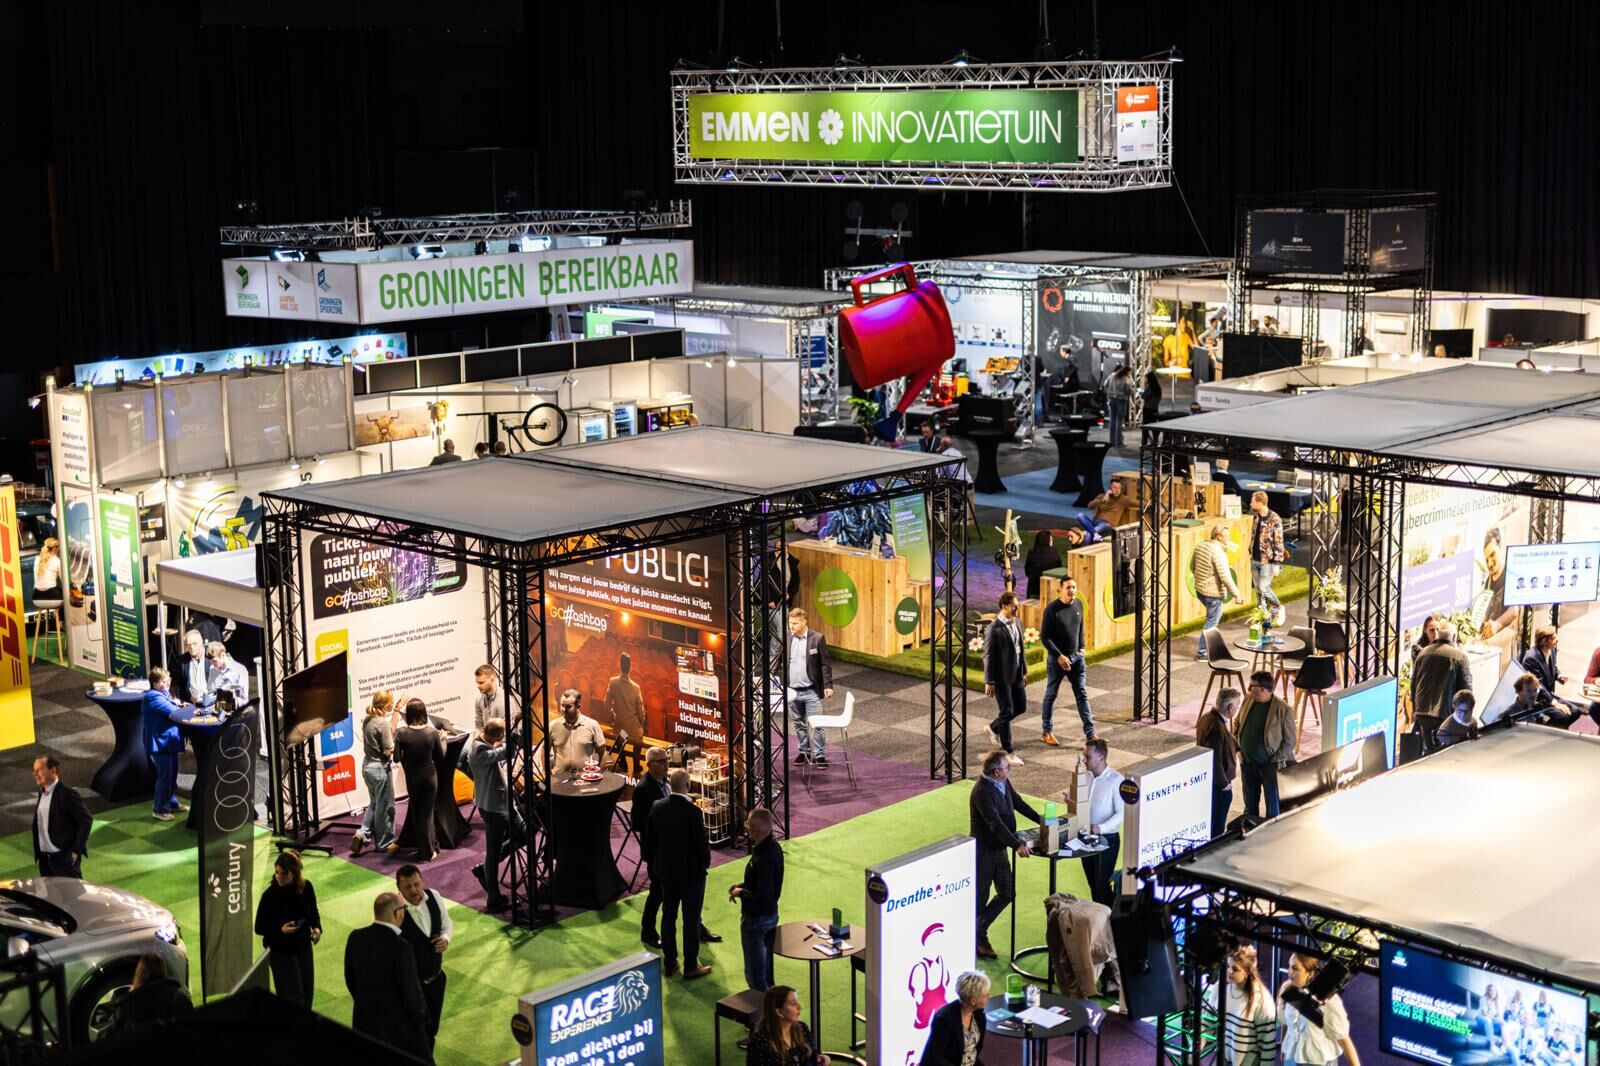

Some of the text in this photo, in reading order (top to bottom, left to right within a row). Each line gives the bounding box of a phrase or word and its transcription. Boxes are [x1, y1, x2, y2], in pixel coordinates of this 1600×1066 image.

[379, 252, 679, 311] GRONINGEN BEREIKBAAR
[324, 548, 393, 570] naar jouw
[324, 563, 377, 588] publiek
[548, 568, 712, 610] Wij zorgen dat jouw bedrijf de juiste aandacht krijgt,
[549, 581, 557, 590] bij
[558, 582, 568, 591] het
[569, 585, 585, 595] juiste
[586, 590, 610, 601] publiek,
[621, 596, 632, 604] het
[632, 598, 650, 609] juiste
[651, 603, 677, 614] moment
[688, 610, 712, 622] kanaal.
[356, 637, 379, 646] Genereer
[416, 622, 450, 633] zichtbaarheid
[320, 642, 344, 652] SOCIAL
[359, 684, 372, 692] hoog
[386, 676, 412, 685] resultaten
[429, 666, 454, 676] bekendste
[386, 671, 400, 679] juiste
[401, 663, 434, 675] zoekwoorden
[435, 657, 458, 667] organisch
[396, 683, 413, 691] Google
[678, 700, 721, 718] Haal hier je
[680, 712, 720, 730] ticket voor
[330, 730, 344, 740] SEA
[675, 722, 726, 743] jouw publiek!
[327, 771, 352, 782] E-MAIL
[1145, 782, 1181, 802] KENNETH
[1190, 772, 1207, 786] SMIT
[1141, 842, 1154, 854] HOE
[1190, 821, 1206, 835] JOUW
[227, 842, 247, 914] century
[886, 887, 933, 913] Drenthe
[944, 877, 971, 895] tours
[1392, 1001, 1469, 1028] OOK DE TALENTEN
[1392, 1007, 1410, 1017] VAN
[1412, 1013, 1423, 1022] DE
[546, 1052, 578, 1066] Kom
[581, 1030, 632, 1058] dichter
[634, 1018, 653, 1037] bij
[606, 1051, 615, 1064] 1
[617, 1042, 645, 1060] dan
